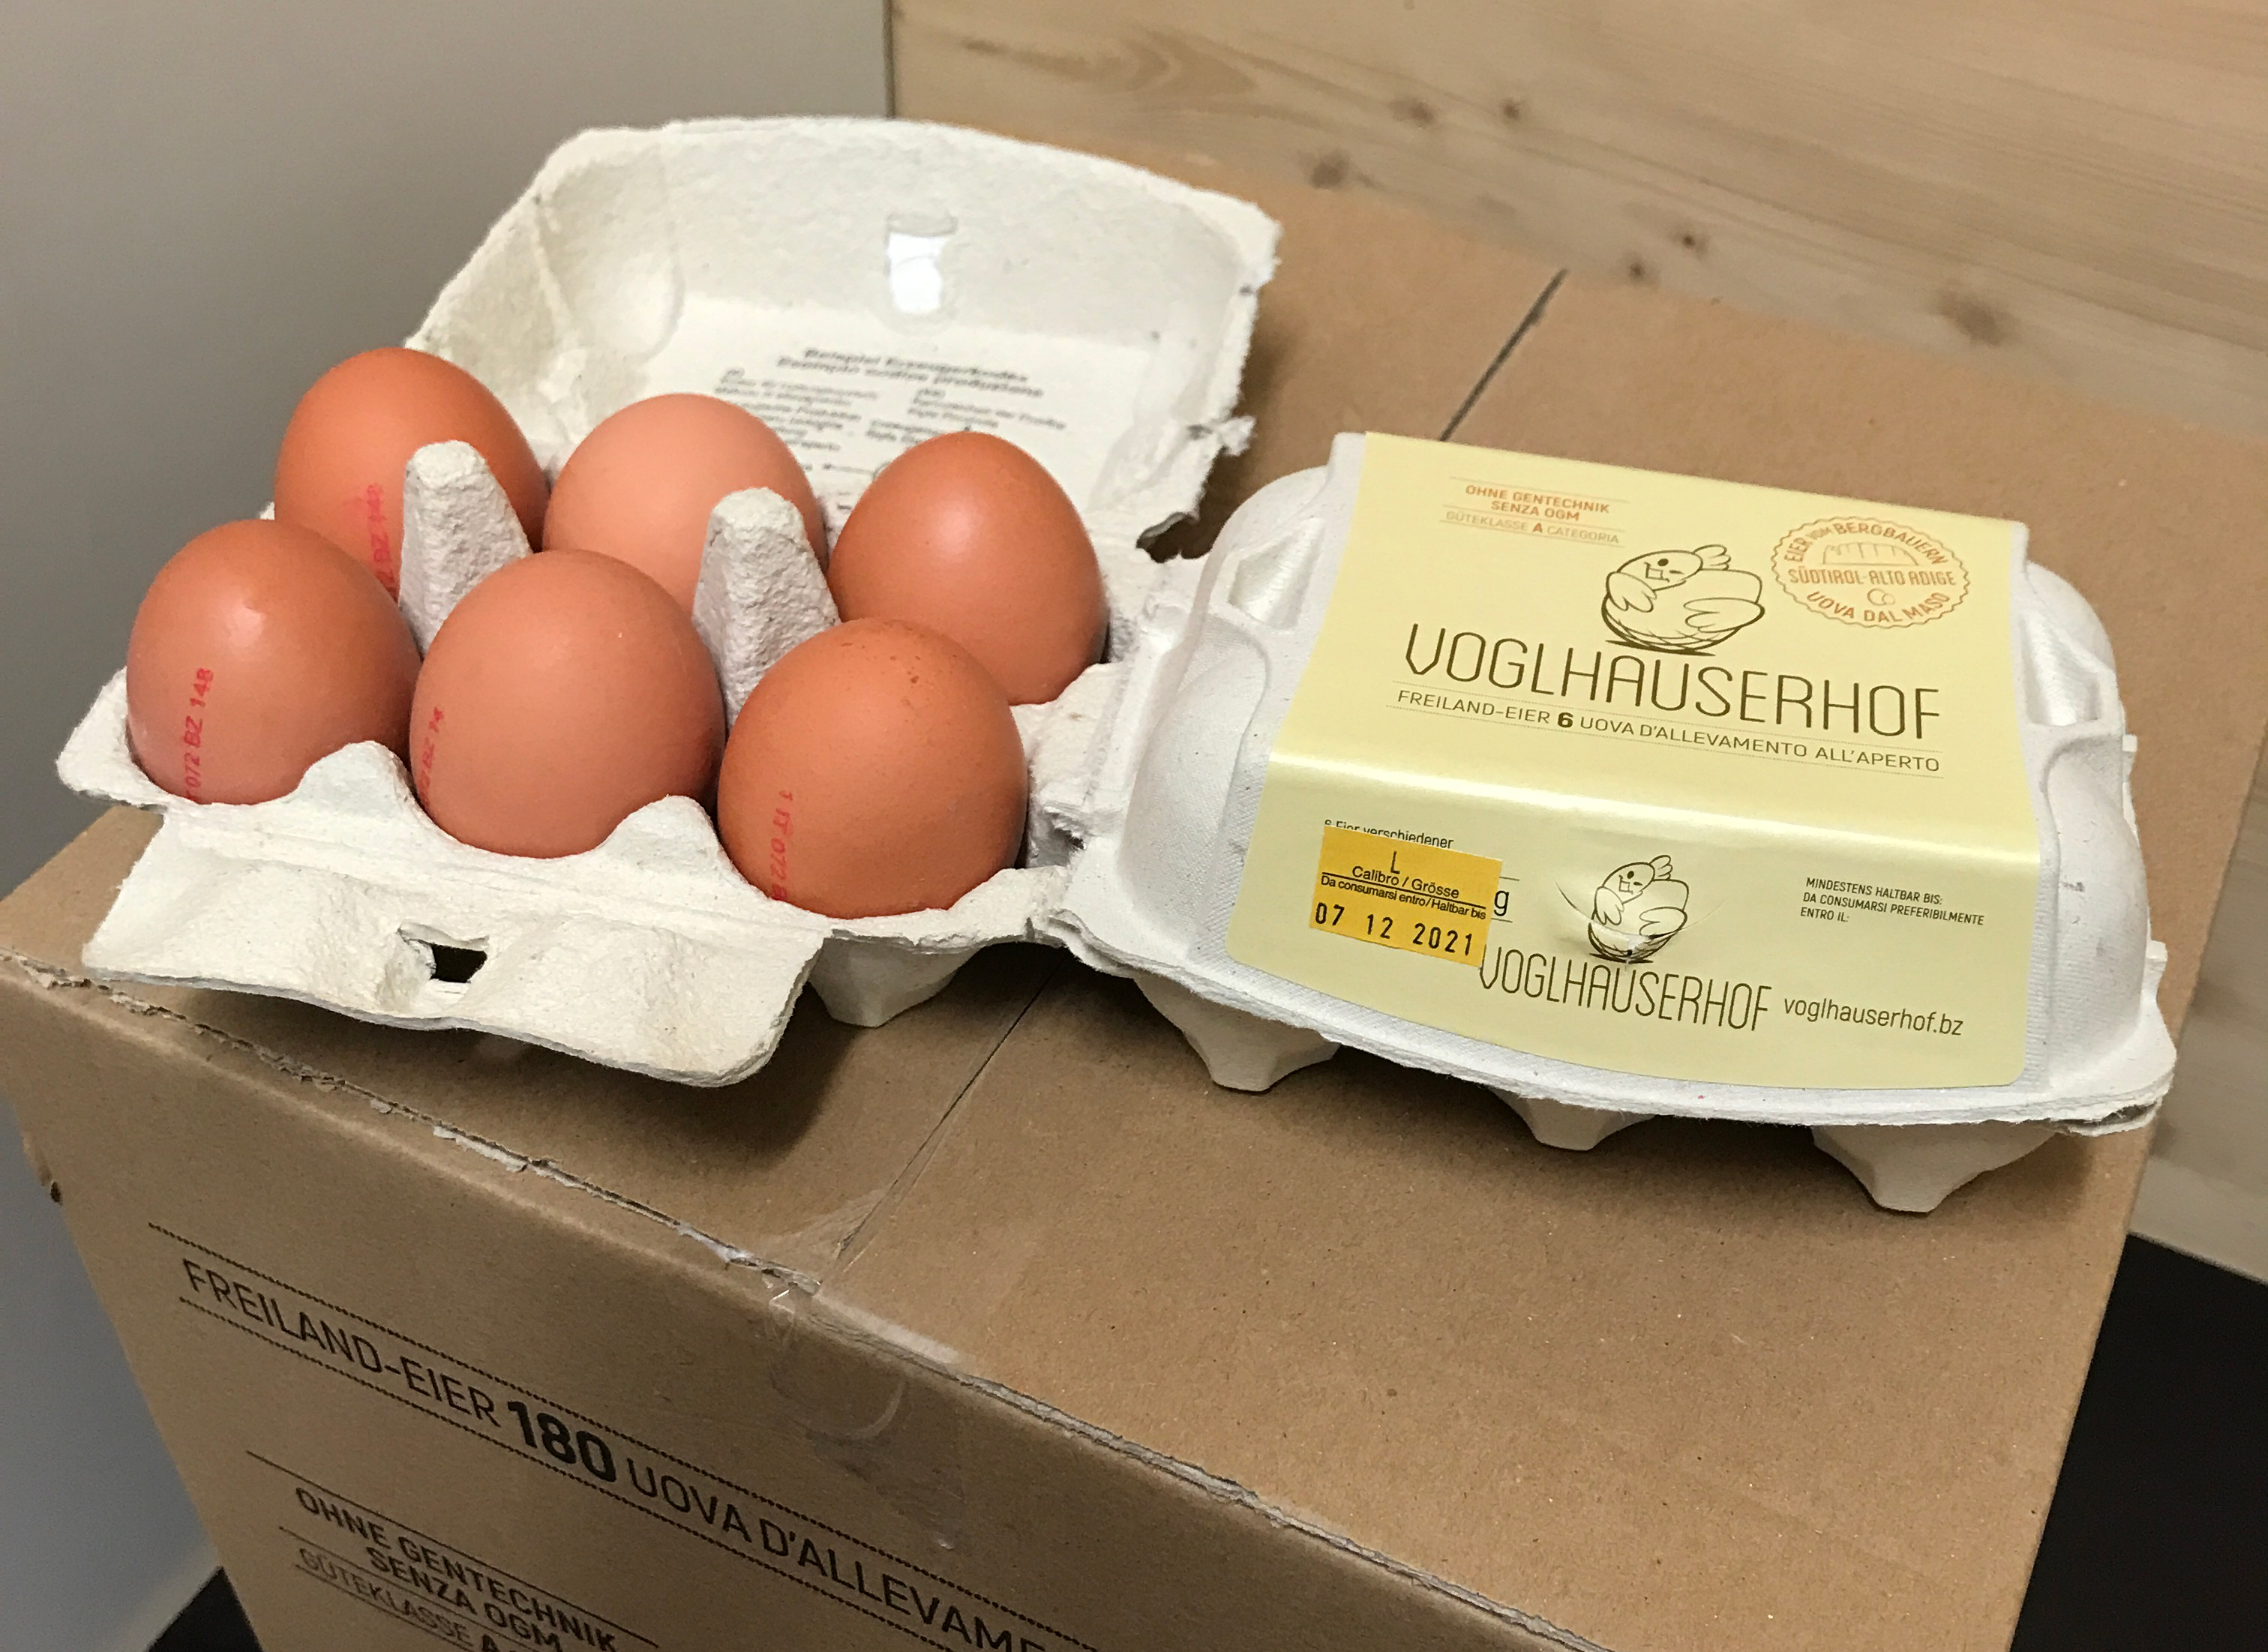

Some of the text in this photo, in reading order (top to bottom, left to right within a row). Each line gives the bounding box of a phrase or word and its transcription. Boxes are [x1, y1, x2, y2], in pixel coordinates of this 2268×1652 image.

[1466, 484, 1610, 513] OHNE GENTECHNIK
[1491, 500, 1580, 521] SENZA OGM
[1446, 510, 1619, 544] GÜTEKLASSE A CATEGORIA
[1784, 537, 1808, 562] EIER
[1832, 523, 1949, 565] BERGBAUERN
[1909, 571, 1957, 586] ADIGE
[1807, 591, 1950, 623] UOVA DAL MASO
[1406, 623, 1940, 739] VOGLHAUSERHOF
[1397, 690, 1940, 772] FREILAND-EIER 6 UOVA D'ALLEVAMENTO ALL'APERTO
[1390, 851, 1400, 874] L
[1321, 875, 1336, 887] Da
[1338, 880, 1397, 901] consumarsi
[1471, 907, 1486, 919] bis
[1352, 866, 1399, 886] Calibro
[1412, 878, 1460, 899] Grösse
[1806, 877, 1943, 905] MINDESTENS HALTBAR BIS:
[1493, 890, 1510, 916] g
[1801, 907, 1850, 922] ENTRO IL:
[1803, 892, 1984, 925] DA CONSUMARSI PREFERIBILMENTE
[1315, 902, 1473, 956] 07 12 2021
[1480, 944, 1772, 1031] VOGLHAUSERHOF
[1784, 998, 1964, 1036] voglhauserhof.bz
[182, 1258, 501, 1428] FREILAND-EIER
[507, 1400, 616, 1483] 180
[626, 1457, 752, 1543] UOVA
[296, 1487, 617, 1652] OHNE GENTECHNIK
[366, 1546, 563, 1652] SENZA OGM
